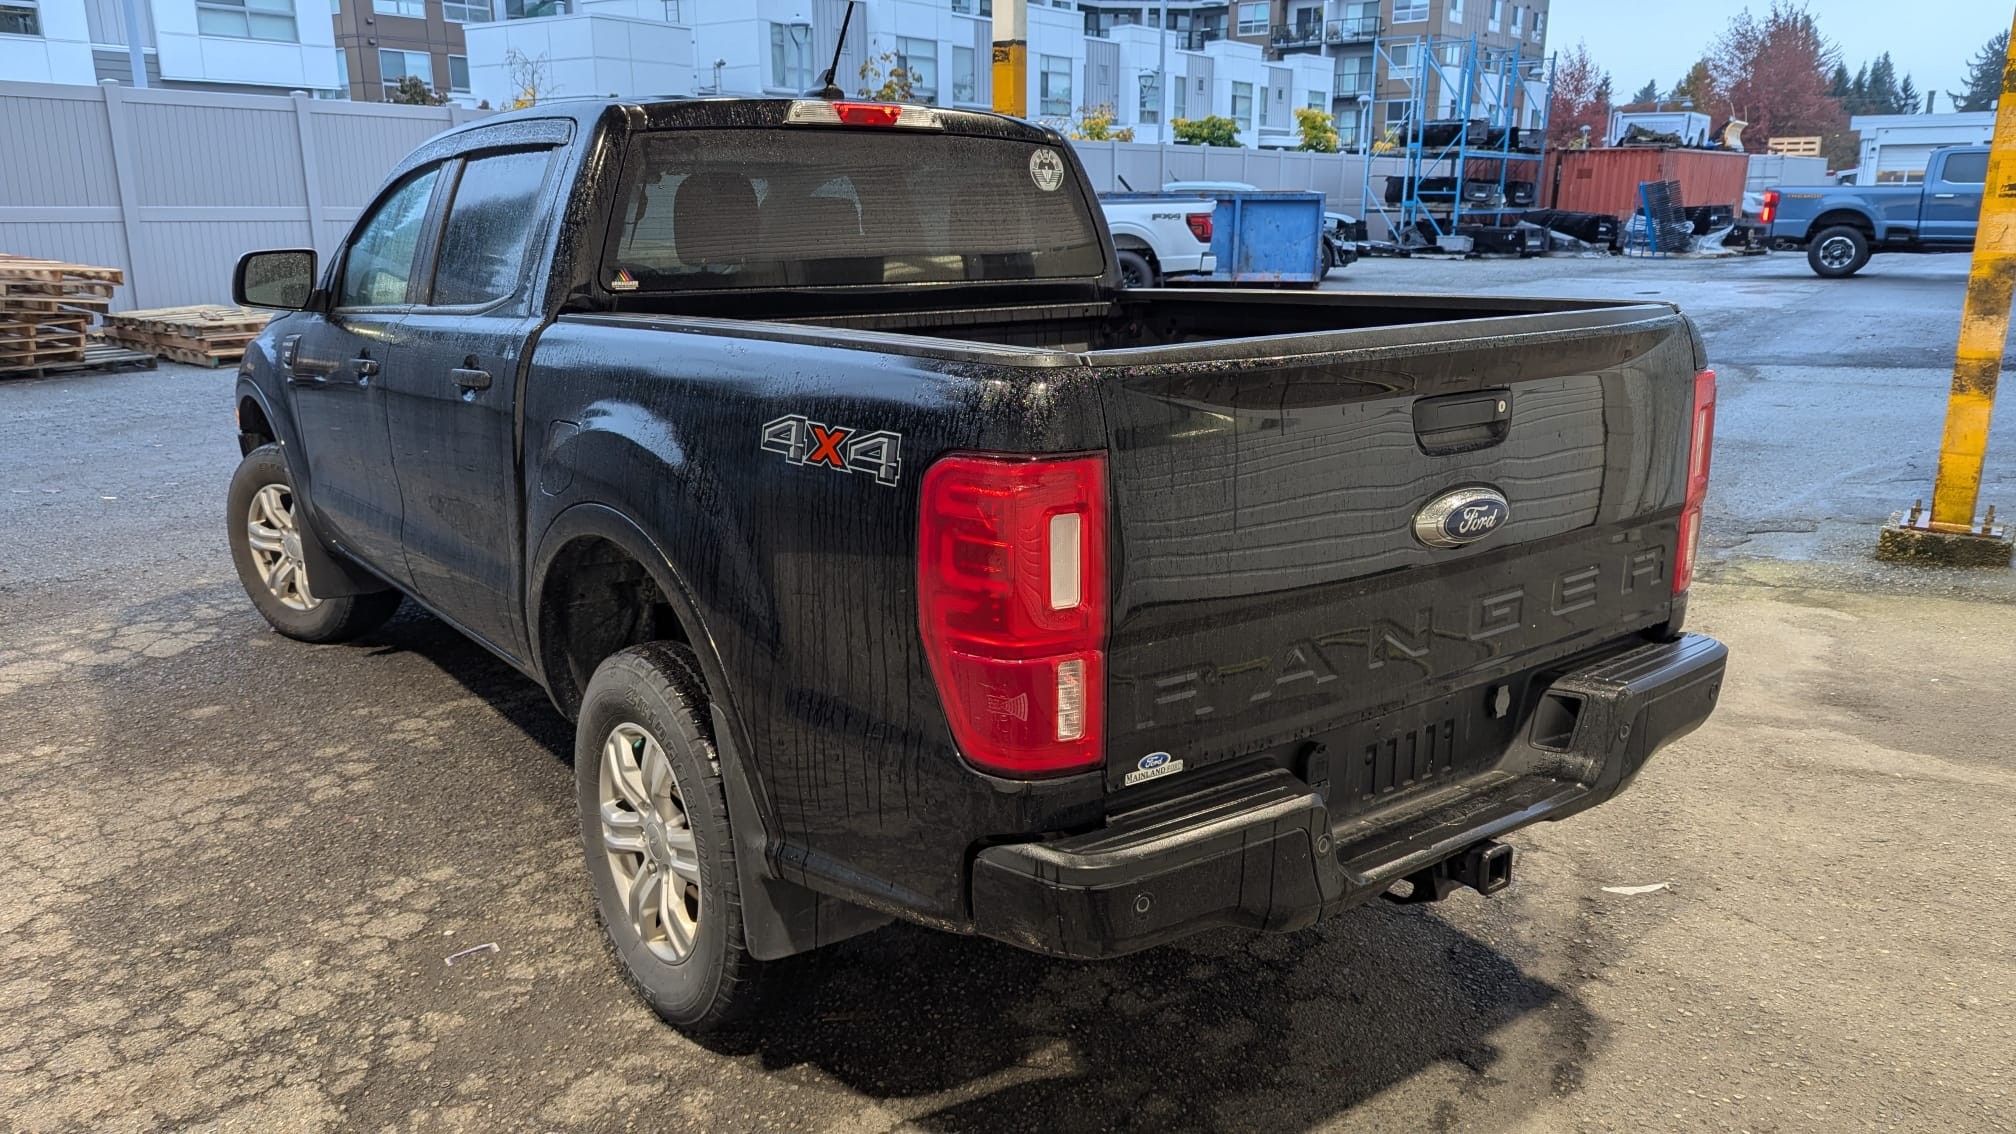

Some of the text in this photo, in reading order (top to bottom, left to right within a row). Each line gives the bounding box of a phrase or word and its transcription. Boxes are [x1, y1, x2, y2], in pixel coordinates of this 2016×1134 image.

[1151, 213, 1181, 221] FX4
[1459, 505, 1498, 534] Ford
[1135, 544, 1665, 730] RANGER
